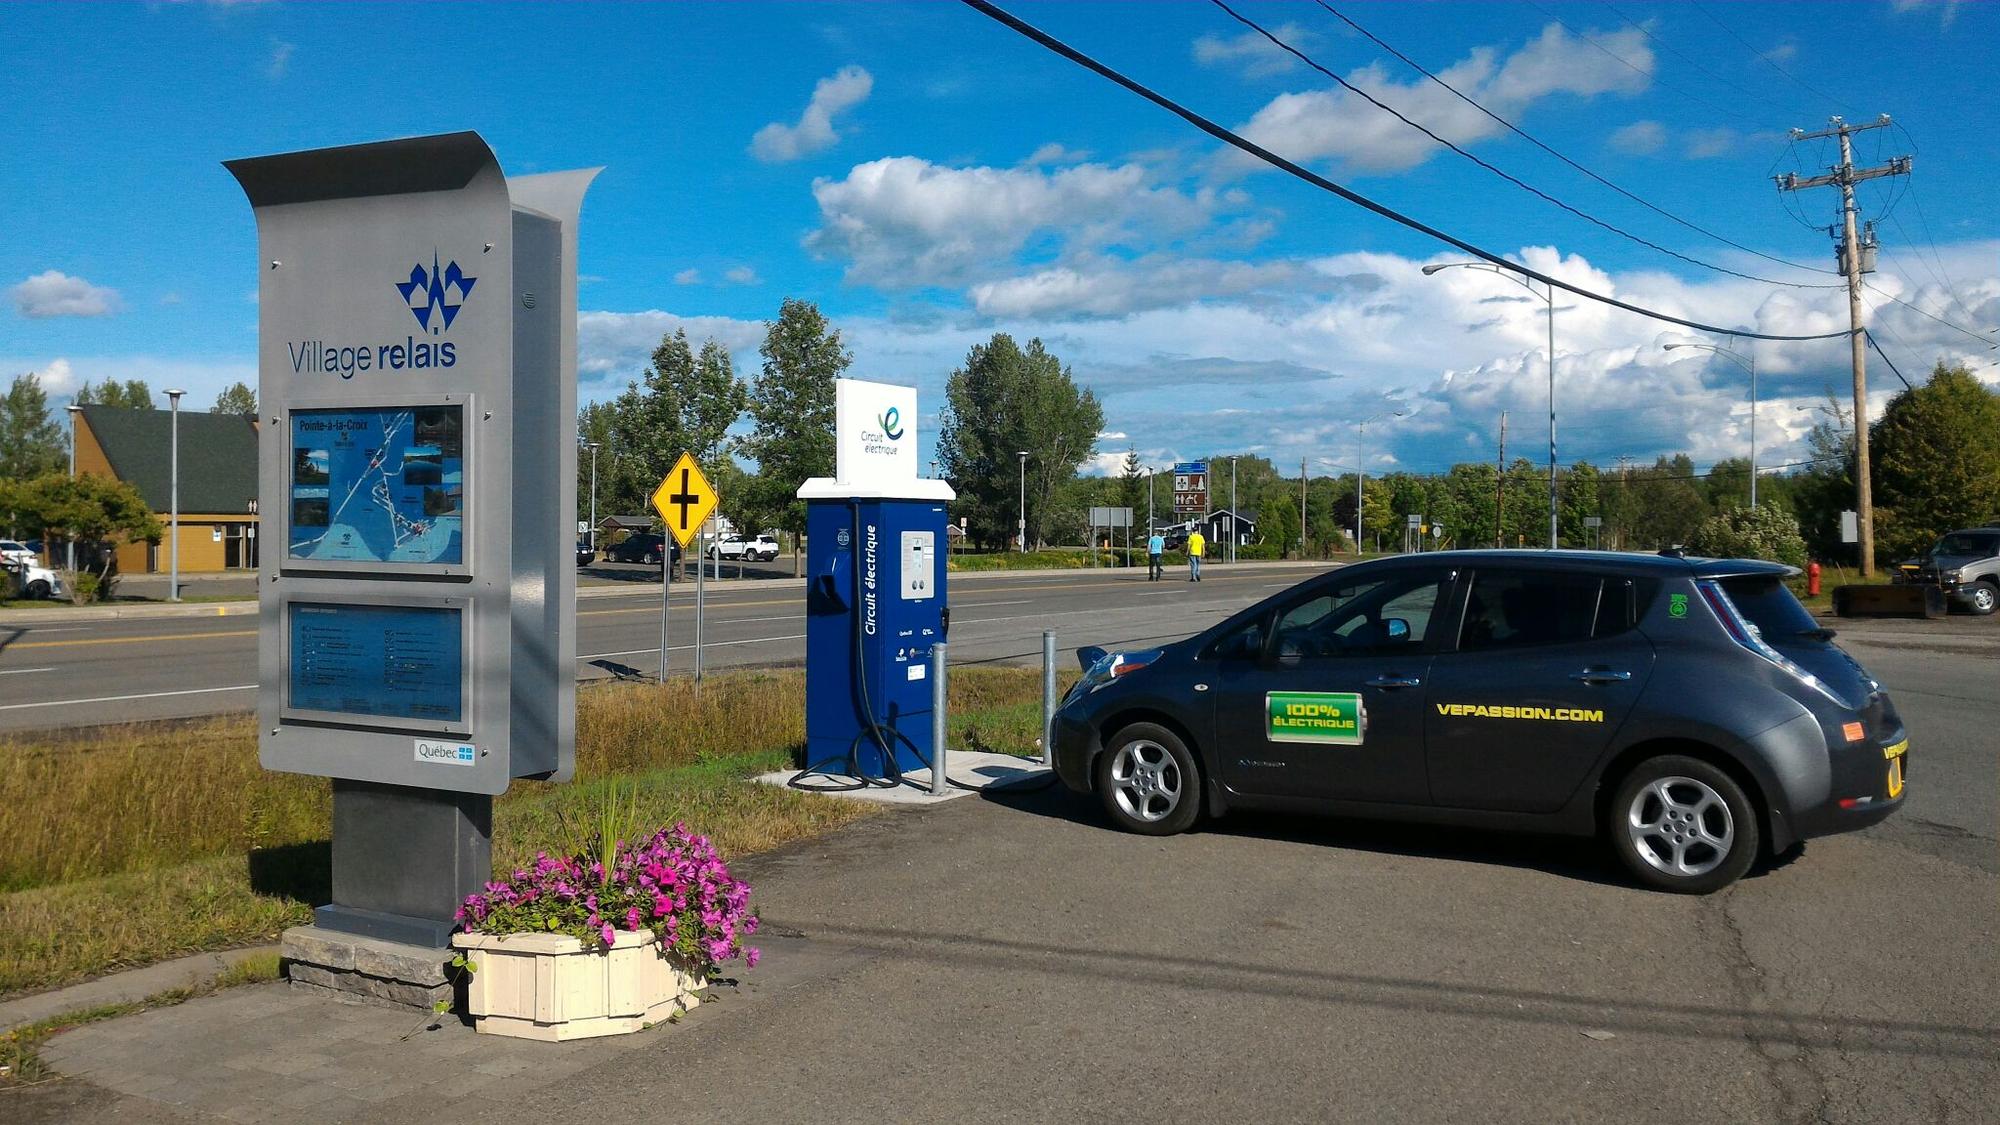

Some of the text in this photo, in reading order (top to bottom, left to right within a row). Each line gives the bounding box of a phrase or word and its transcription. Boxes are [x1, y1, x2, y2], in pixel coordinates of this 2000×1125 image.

[288, 336, 457, 380] Village relais
[861, 430, 883, 443] Circuit
[865, 525, 879, 635] Circuit électrique
[1286, 703, 1341, 717] 100%
[1436, 703, 1604, 723] VEPASSION.COM
[1273, 716, 1355, 729] ÉLECTRIQUE
[419, 743, 457, 759] Québec
